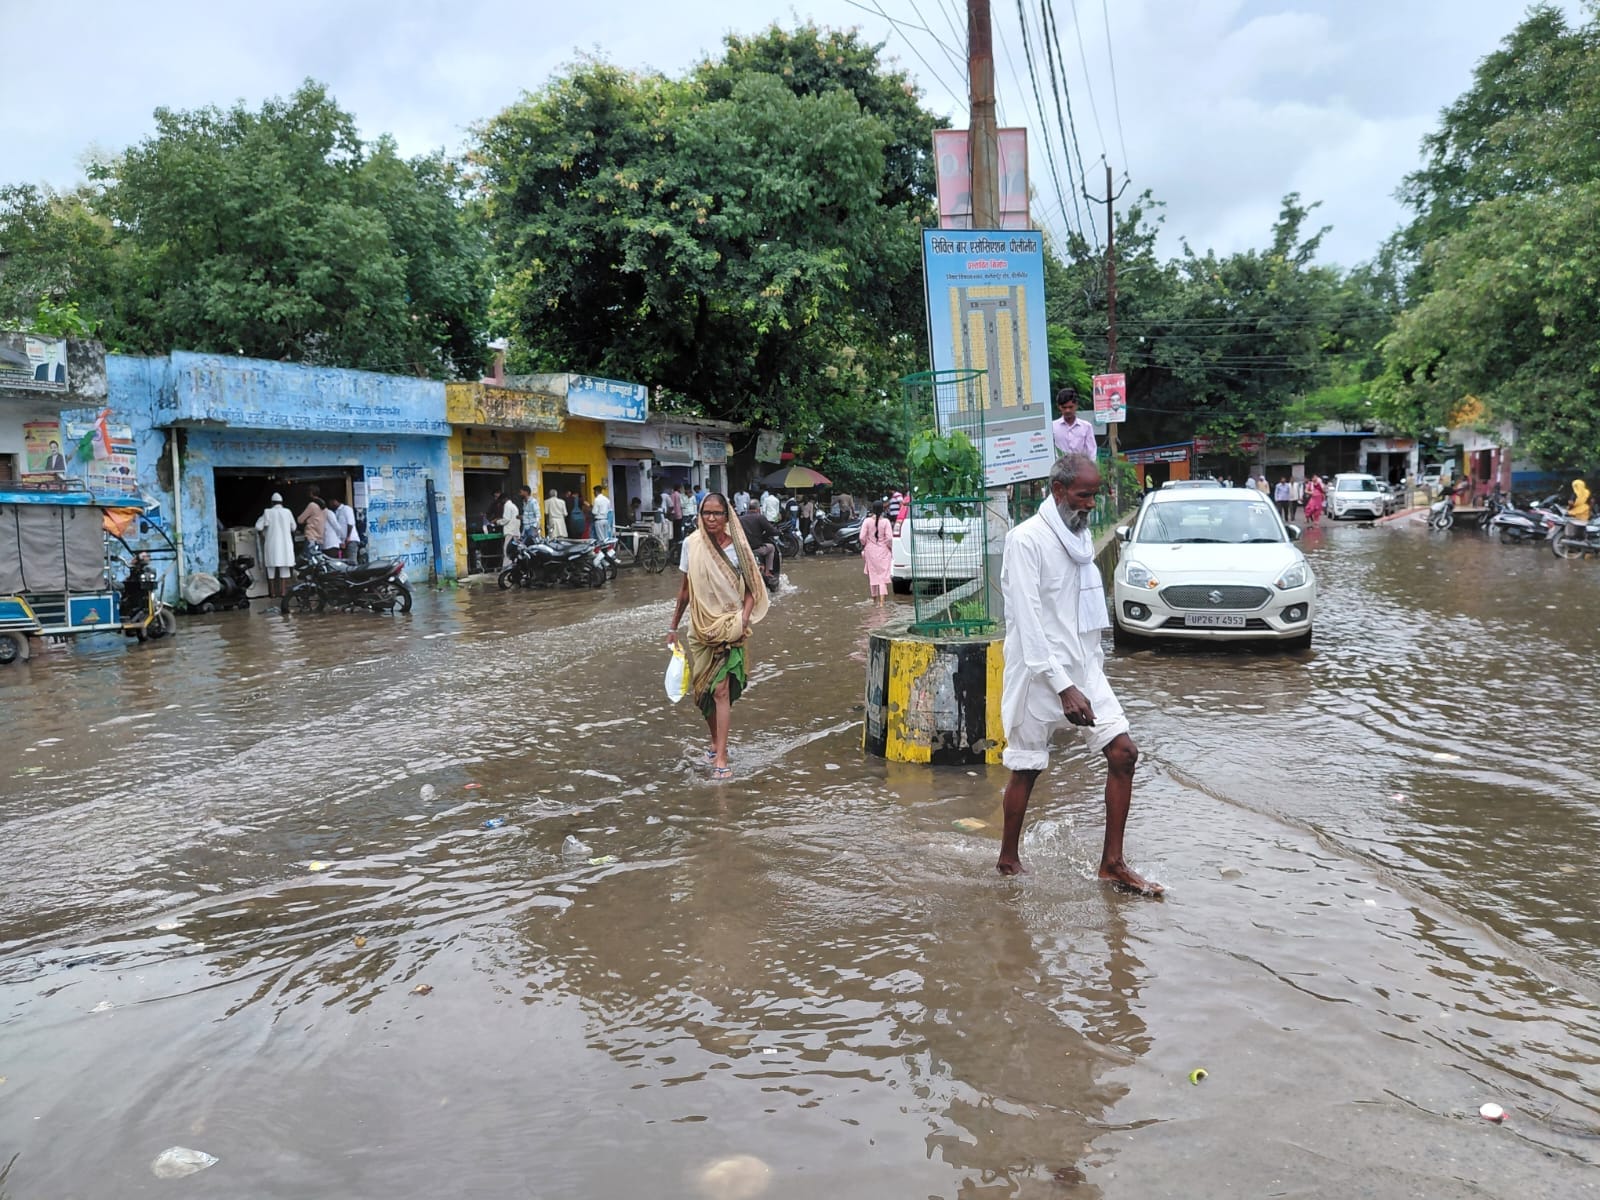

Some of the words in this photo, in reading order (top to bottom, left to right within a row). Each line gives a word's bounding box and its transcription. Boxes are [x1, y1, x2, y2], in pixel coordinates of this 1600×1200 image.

[931, 238, 954, 254] सिविल
[956, 241, 967, 254] बार
[1009, 238, 1037, 254] पीलीभीत
[410, 547, 428, 566] फार्म
